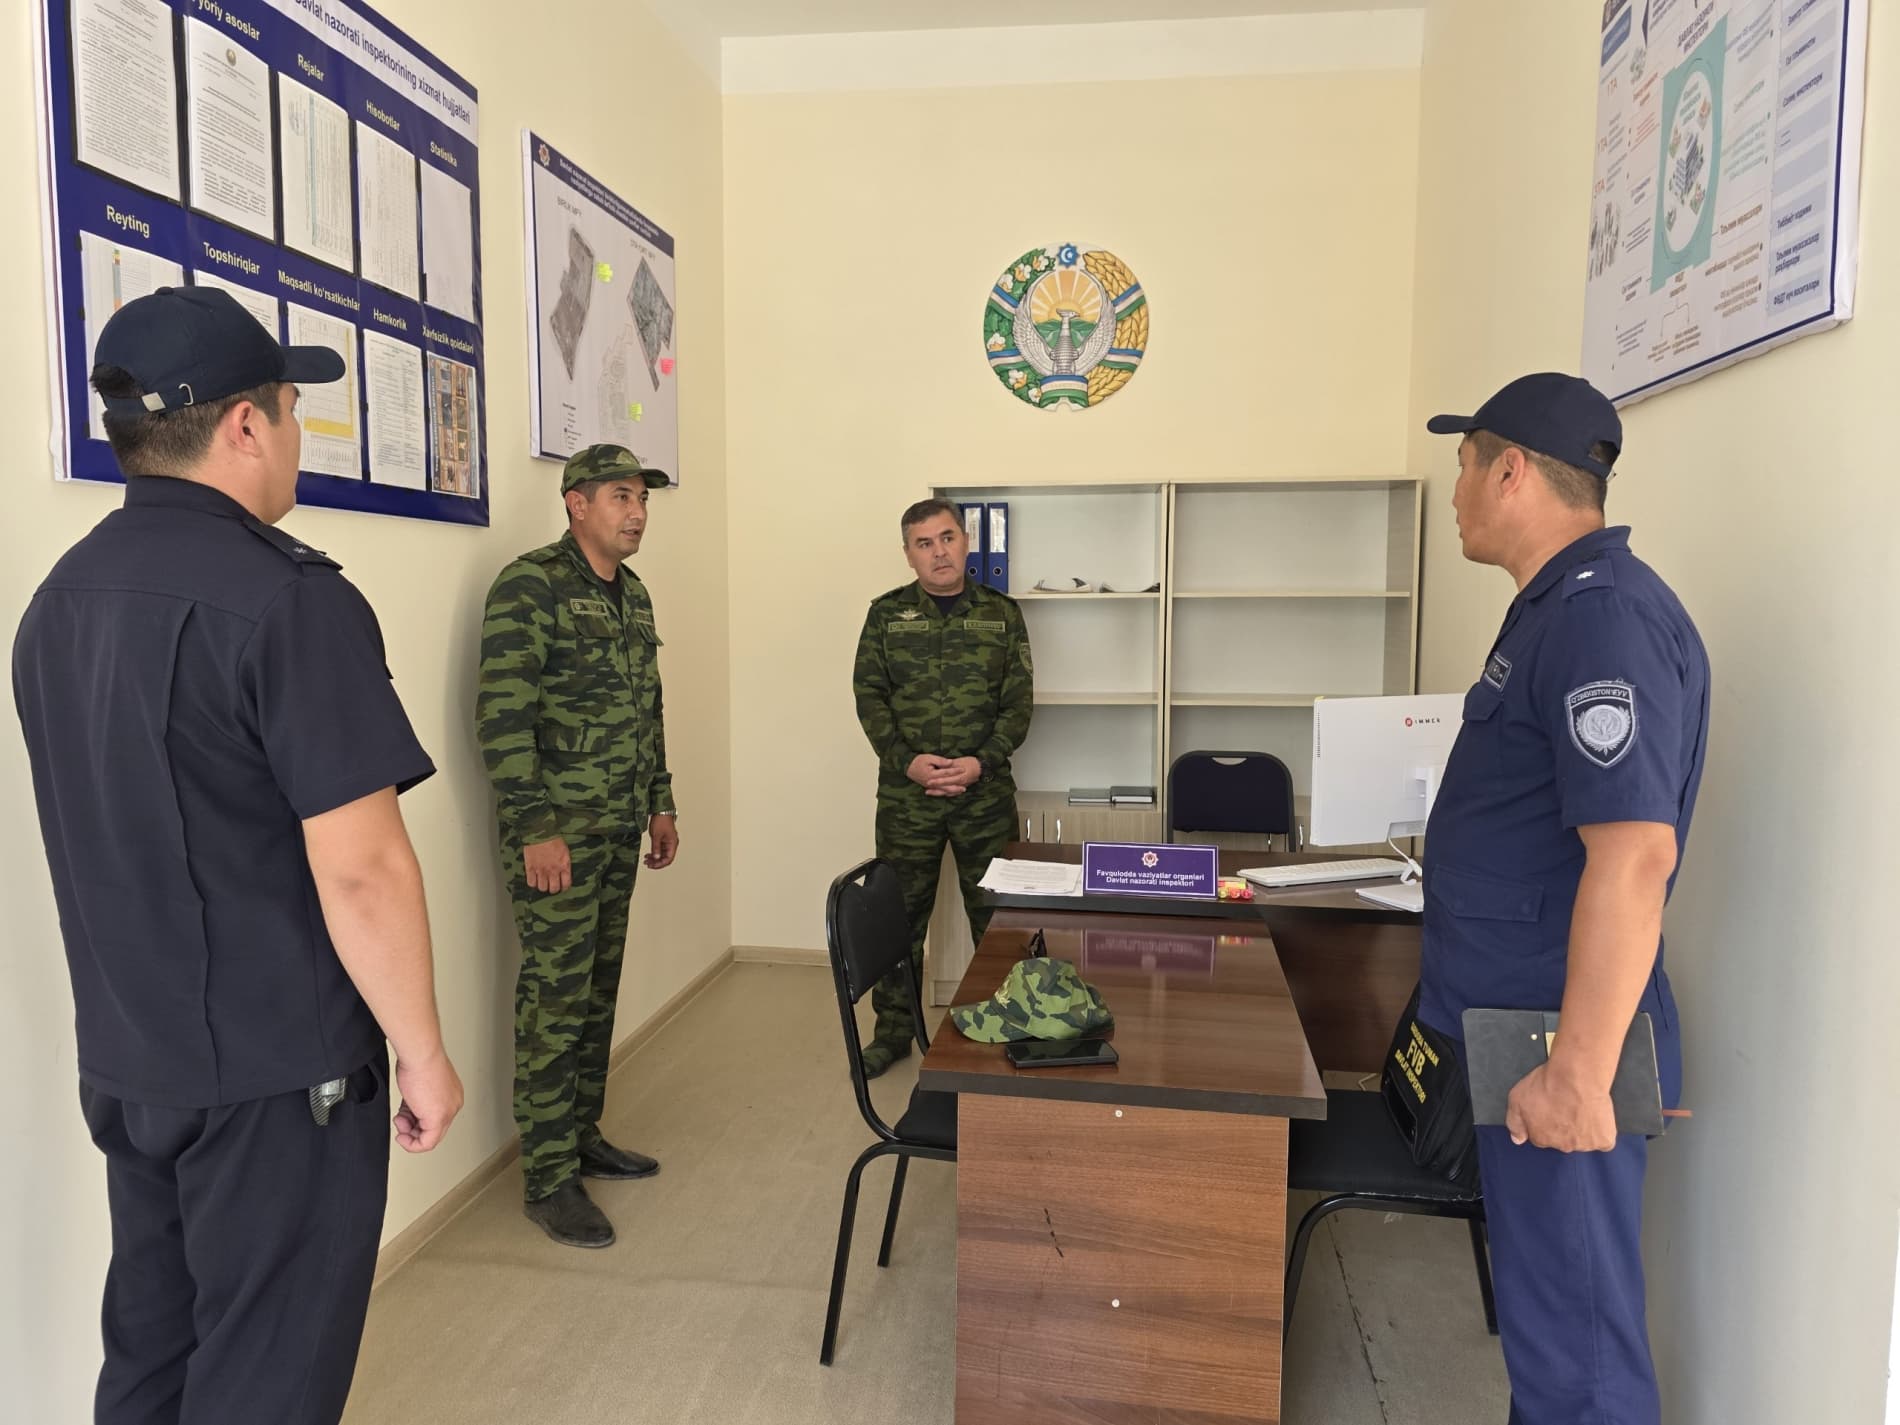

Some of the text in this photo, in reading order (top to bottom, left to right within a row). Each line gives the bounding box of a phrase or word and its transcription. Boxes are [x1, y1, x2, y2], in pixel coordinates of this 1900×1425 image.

[225, 12, 260, 40] asoslar
[298, 53, 325, 81] Rejalar
[325, 12, 360, 46] nazorati
[362, 33, 416, 90] inspektorining
[418, 76, 441, 104] xizmat
[366, 99, 400, 131] Hisobotlar
[430, 141, 457, 167] Statistika
[106, 205, 150, 238] Reyting
[203, 242, 261, 276] Topshiriqlar
[278, 269, 312, 294] Maqsadli
[373, 308, 408, 331] Hamkorlik
[1096, 869, 1205, 882] Favqulodda vaziyatlar organlari
[1105, 876, 1195, 888] Davlat nazorati inspektori
